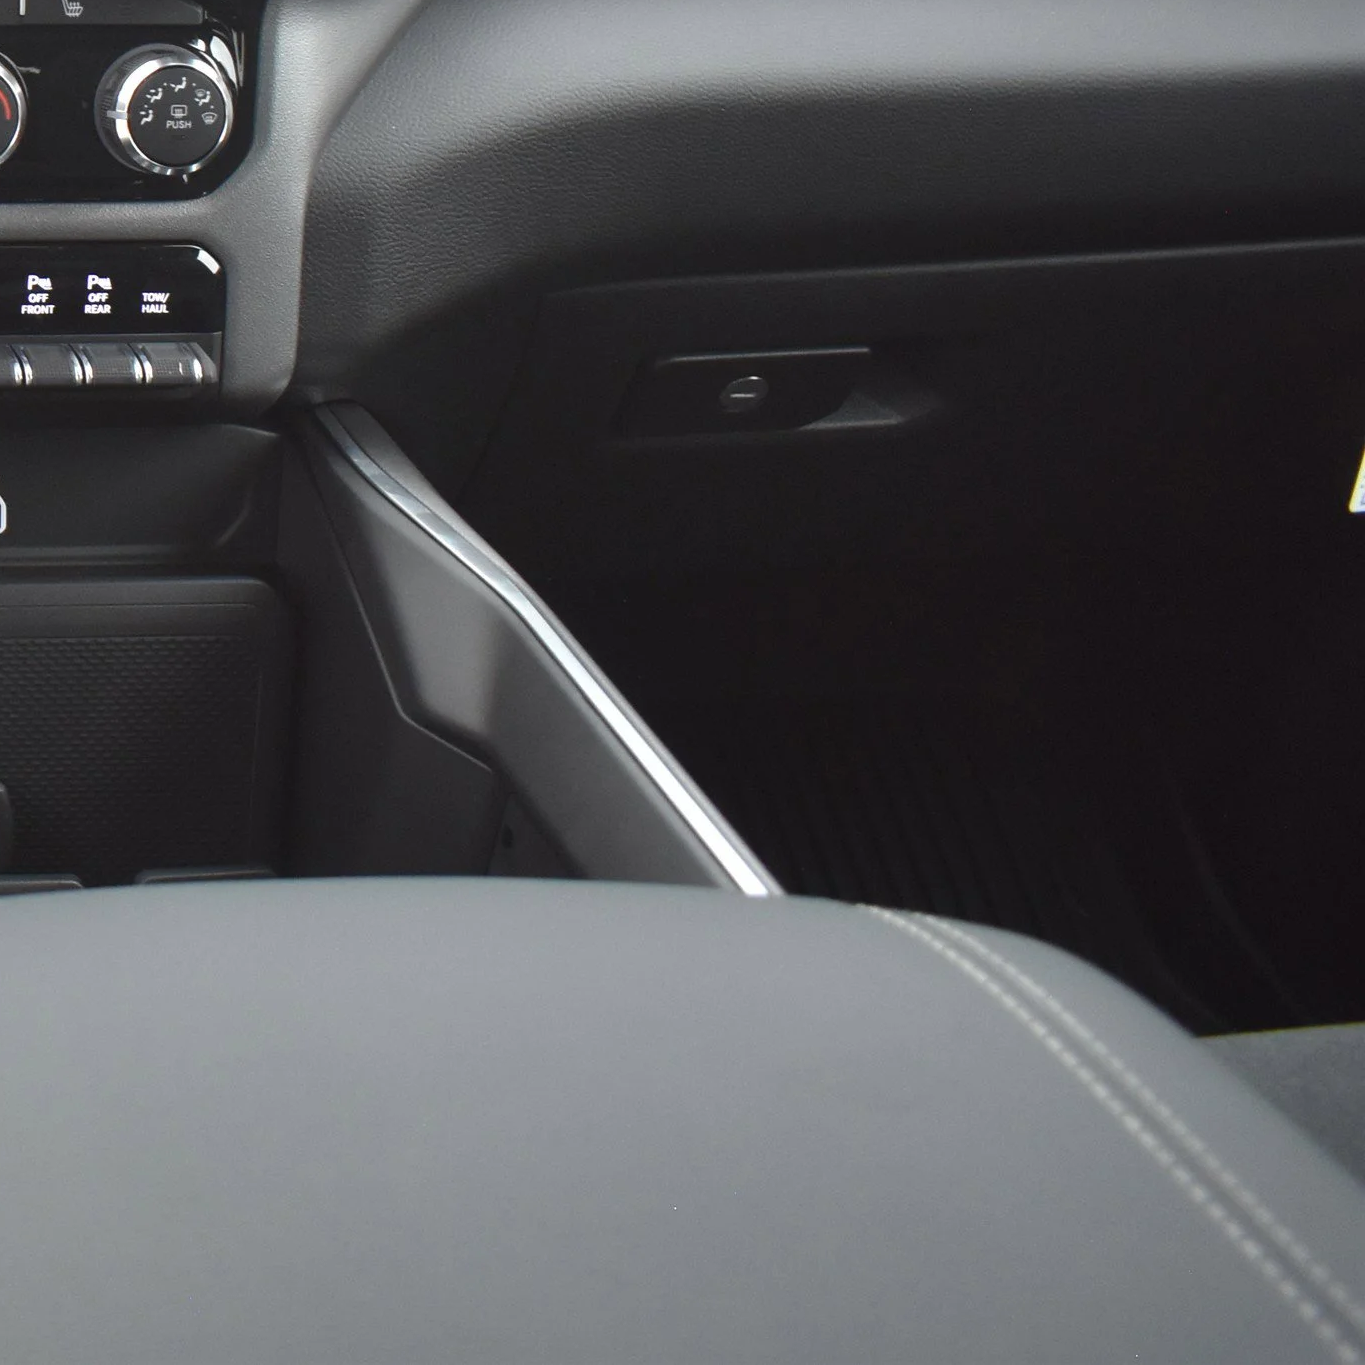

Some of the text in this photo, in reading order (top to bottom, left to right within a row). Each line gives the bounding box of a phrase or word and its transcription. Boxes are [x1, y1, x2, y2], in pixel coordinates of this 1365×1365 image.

[166, 120, 192, 129] PUSH
[28, 293, 49, 303] OFF
[88, 293, 109, 303] OFF
[142, 292, 169, 303] TOW/
[21, 305, 55, 315] FRONT
[84, 305, 111, 314] REAR
[141, 304, 169, 314] HAUL
